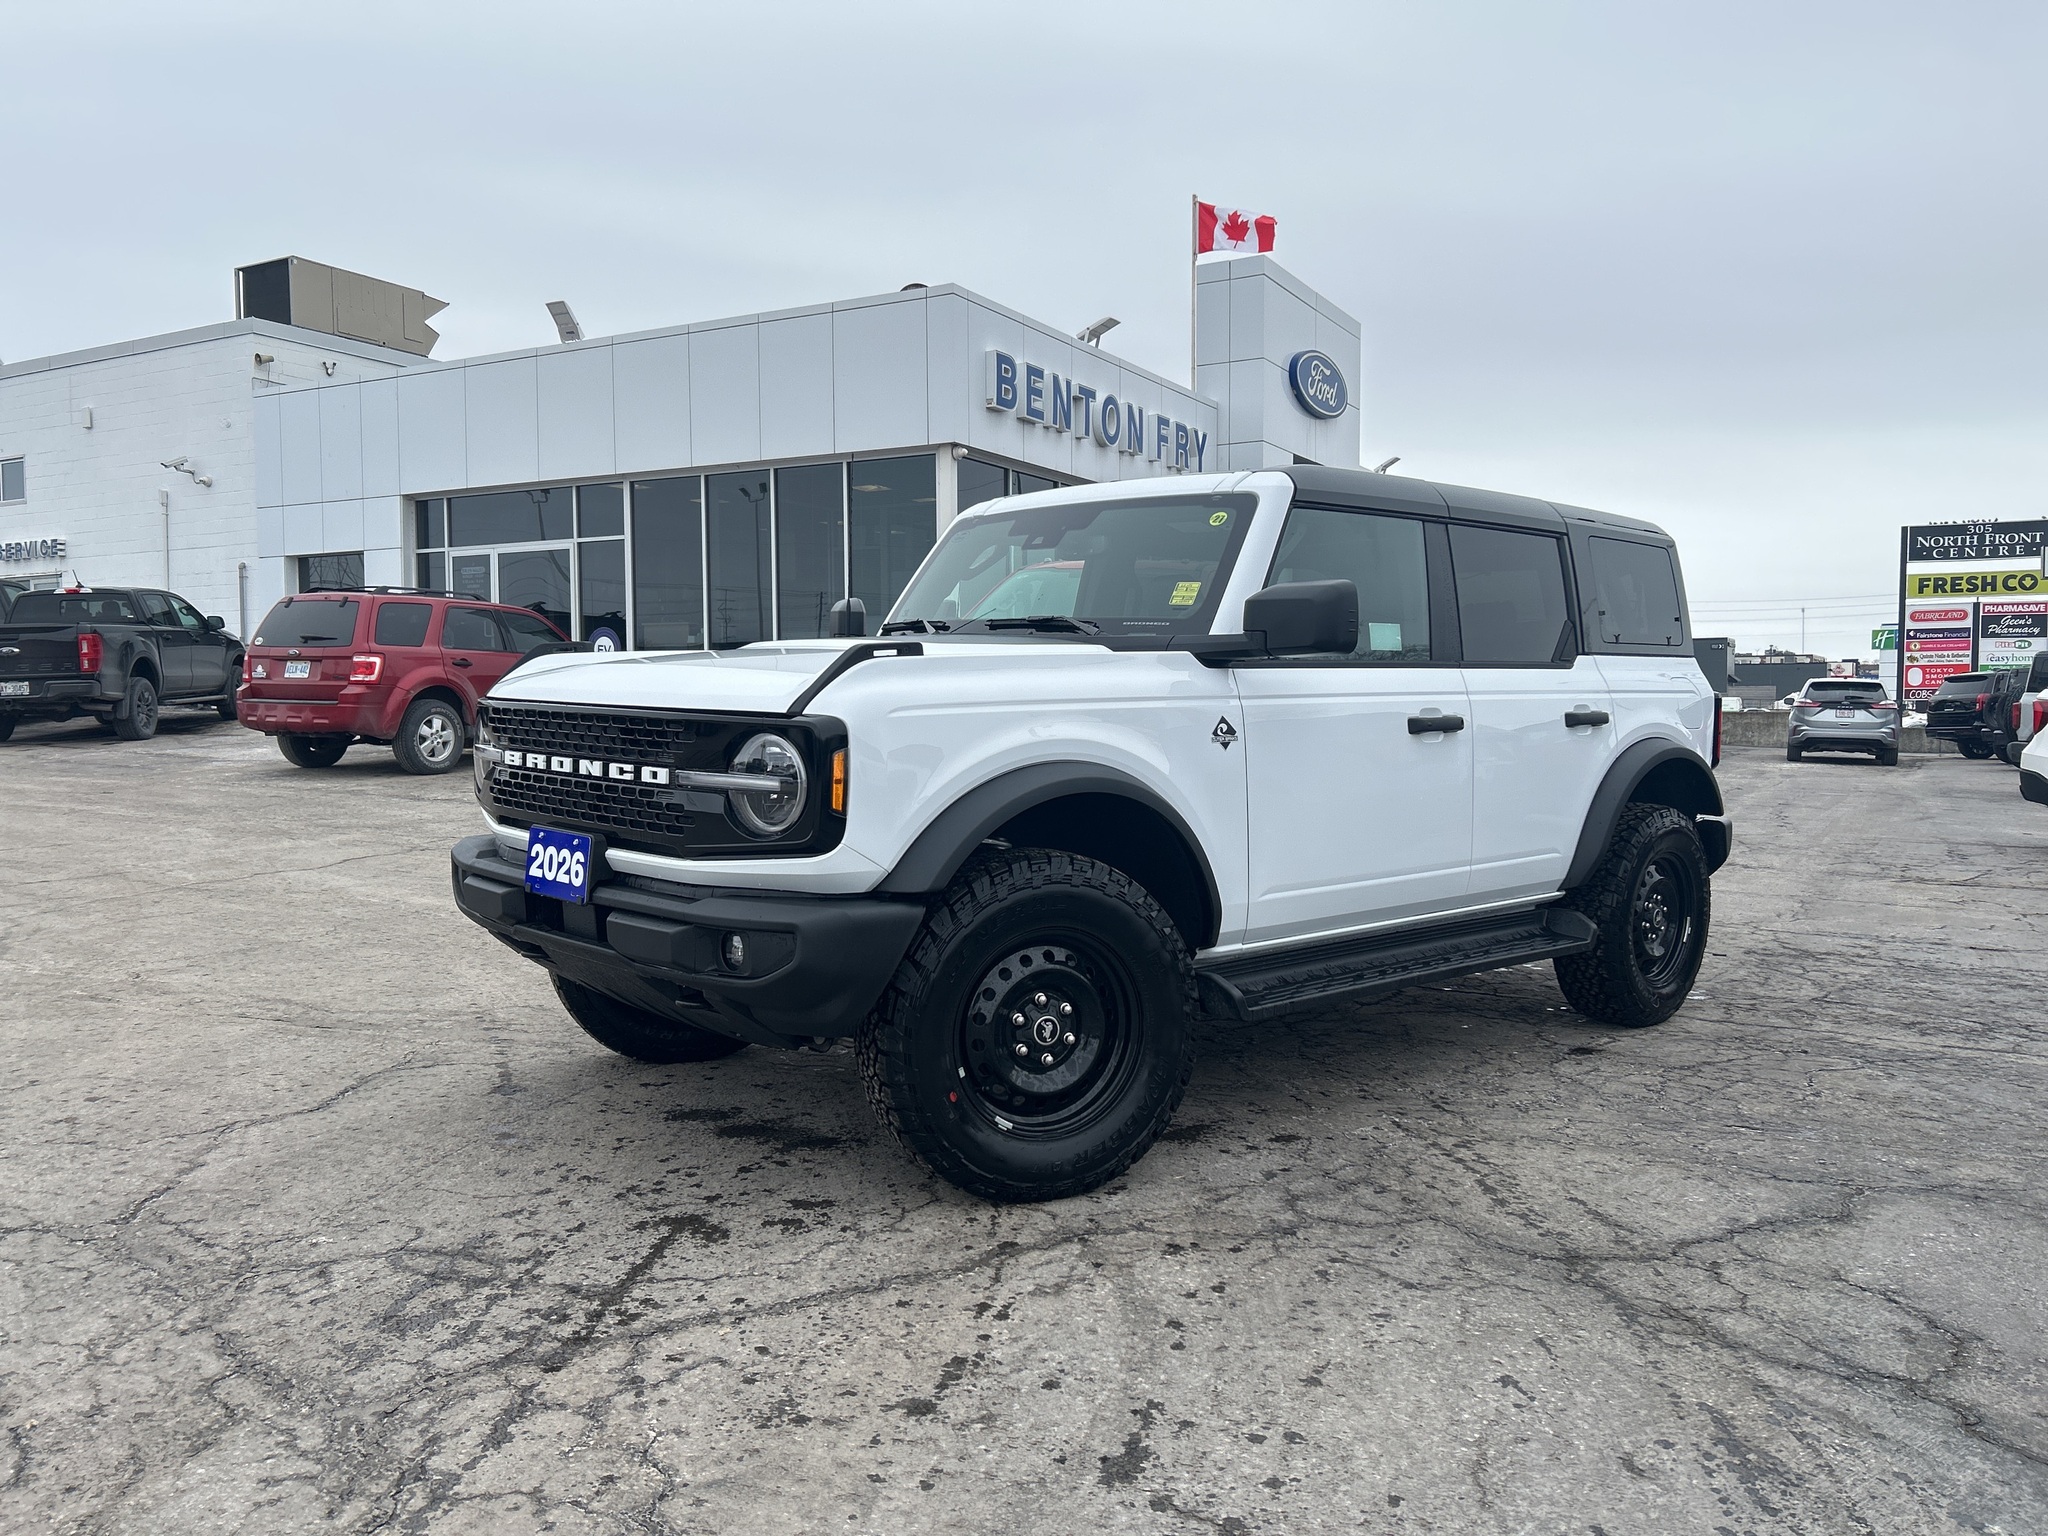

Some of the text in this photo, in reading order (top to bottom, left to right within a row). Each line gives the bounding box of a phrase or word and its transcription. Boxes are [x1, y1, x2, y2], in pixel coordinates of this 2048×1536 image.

[1307, 360, 1338, 408] Ford
[987, 350, 1208, 473] BENTON FRY
[1966, 524, 1993, 534] 305
[1916, 532, 2045, 548] NORTH FRONT
[1932, 545, 2025, 558] CENTRE
[1917, 573, 2039, 595] FRESH CO
[1984, 604, 2046, 612] PHARMASAVE
[1914, 611, 1964, 621] FABRICLAND
[1987, 624, 2041, 635] Pharmacy
[1989, 653, 2034, 664] easyhom
[503, 750, 670, 785] BRONCO
[528, 843, 585, 887] 2026
